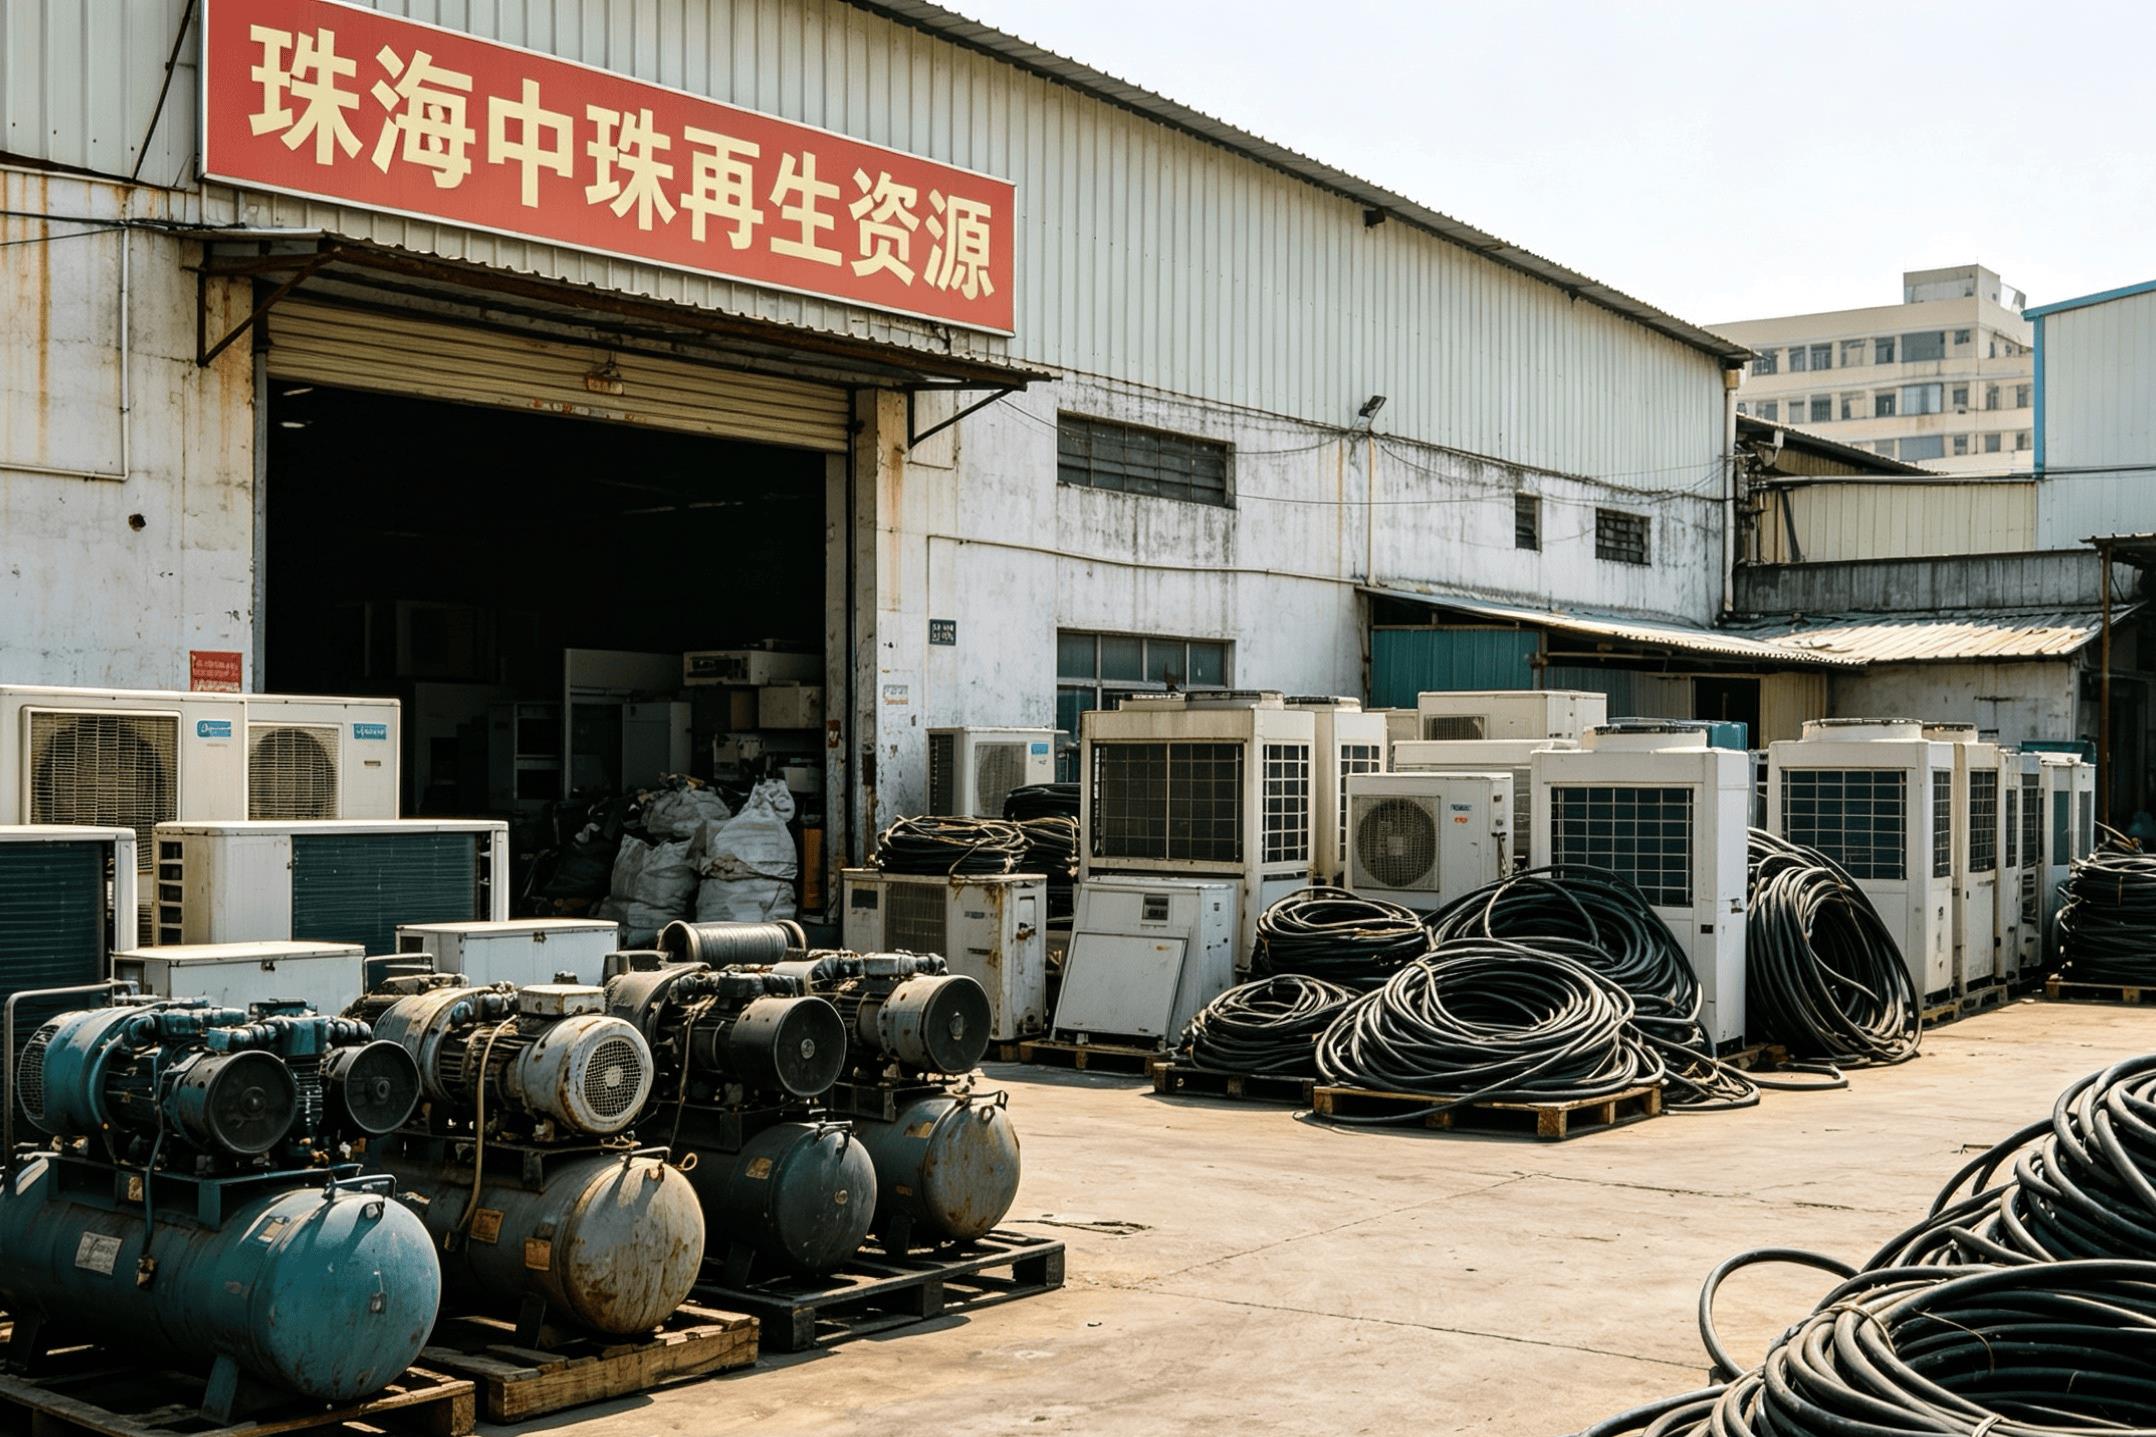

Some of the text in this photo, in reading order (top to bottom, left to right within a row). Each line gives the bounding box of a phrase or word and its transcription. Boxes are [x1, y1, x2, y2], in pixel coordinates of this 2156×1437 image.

[249, 24, 995, 300] 珠海中珠再生资源
